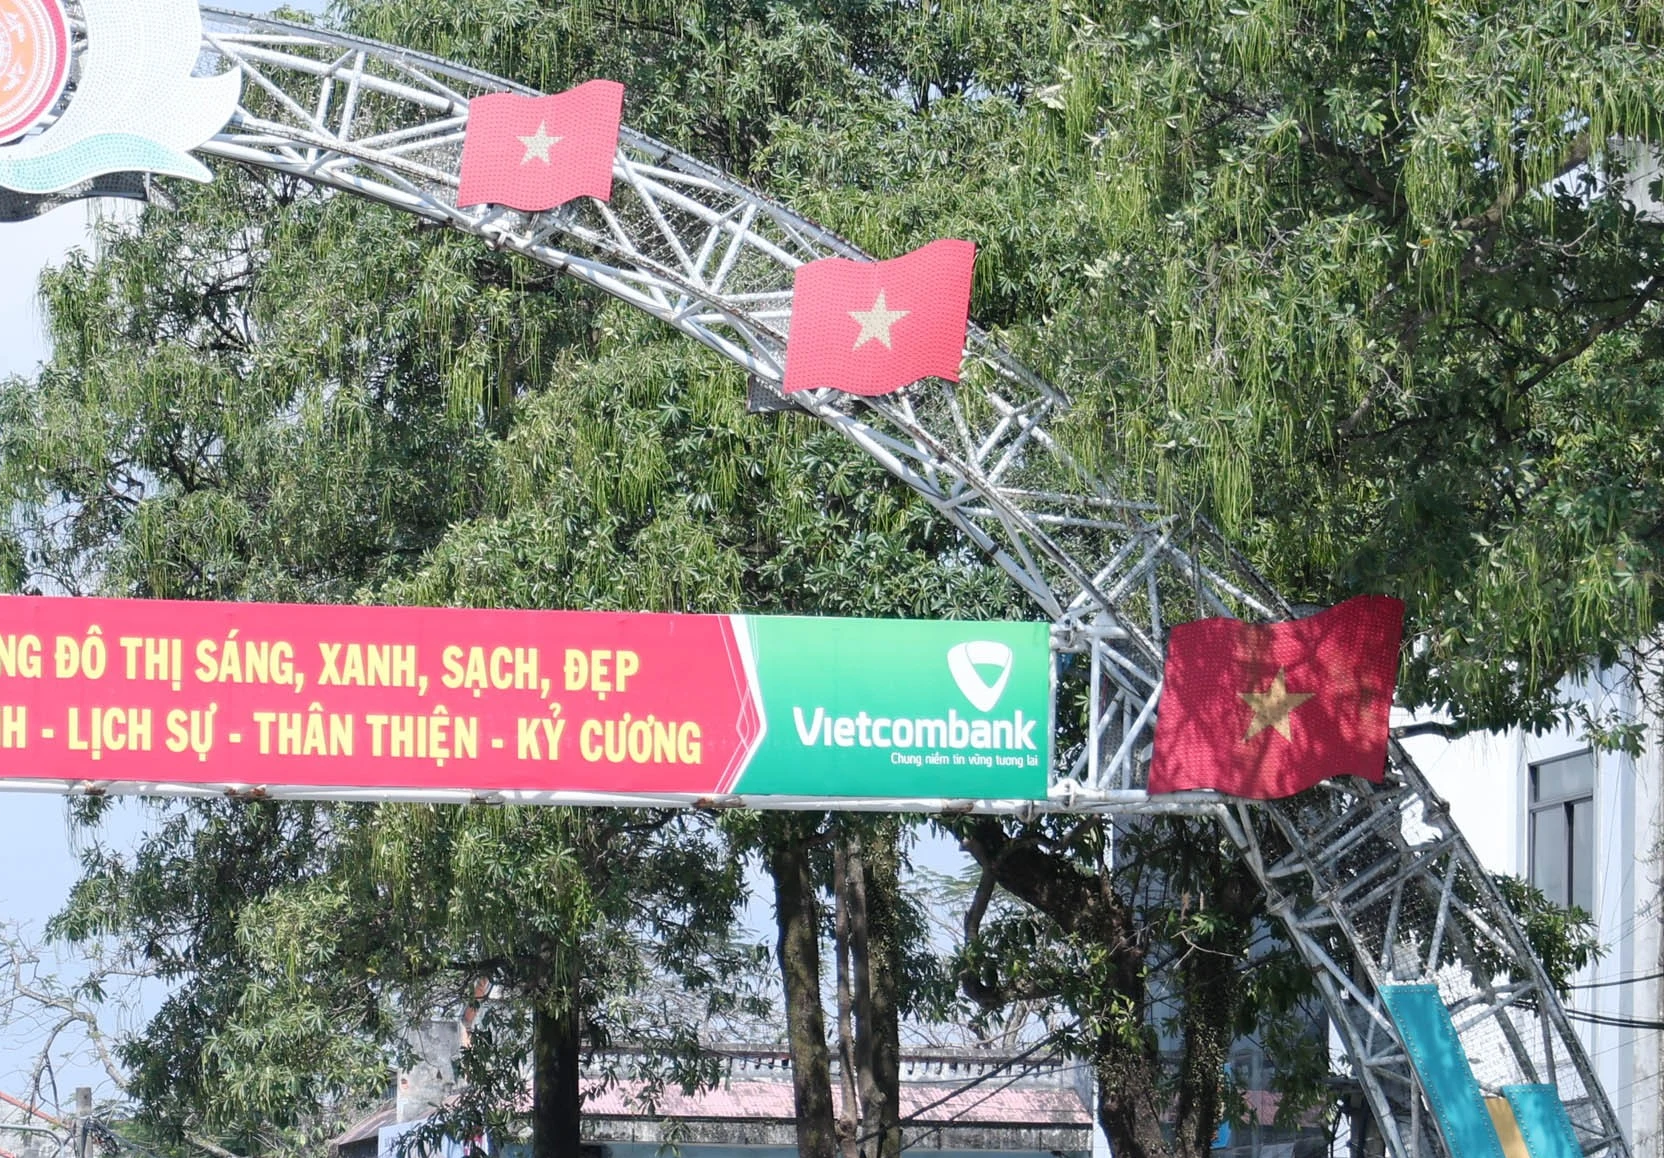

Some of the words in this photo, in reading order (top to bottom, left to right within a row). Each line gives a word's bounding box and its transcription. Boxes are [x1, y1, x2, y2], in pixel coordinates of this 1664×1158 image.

[54, 625, 106, 679] ĐÔ
[120, 637, 181, 691] THỊ
[195, 629, 304, 693] SÁNG,
[318, 643, 428, 696] XANH,
[442, 645, 550, 698] SẠCH,
[564, 649, 639, 700] ĐẸP
[42, 728, 54, 738] -
[69, 707, 151, 760] LỊCH
[166, 702, 218, 761] SỰ
[229, 733, 241, 742] -
[253, 702, 353, 756] THÂN
[366, 705, 477, 767] THIỆN
[492, 739, 503, 748] -
[518, 702, 565, 760] KỶ
[580, 713, 701, 764] CƯƠNG
[793, 707, 1036, 750] Vietcombank
[891, 752, 922, 767] Chung
[953, 754, 966, 765] tin
[1027, 755, 1039, 766] lai
